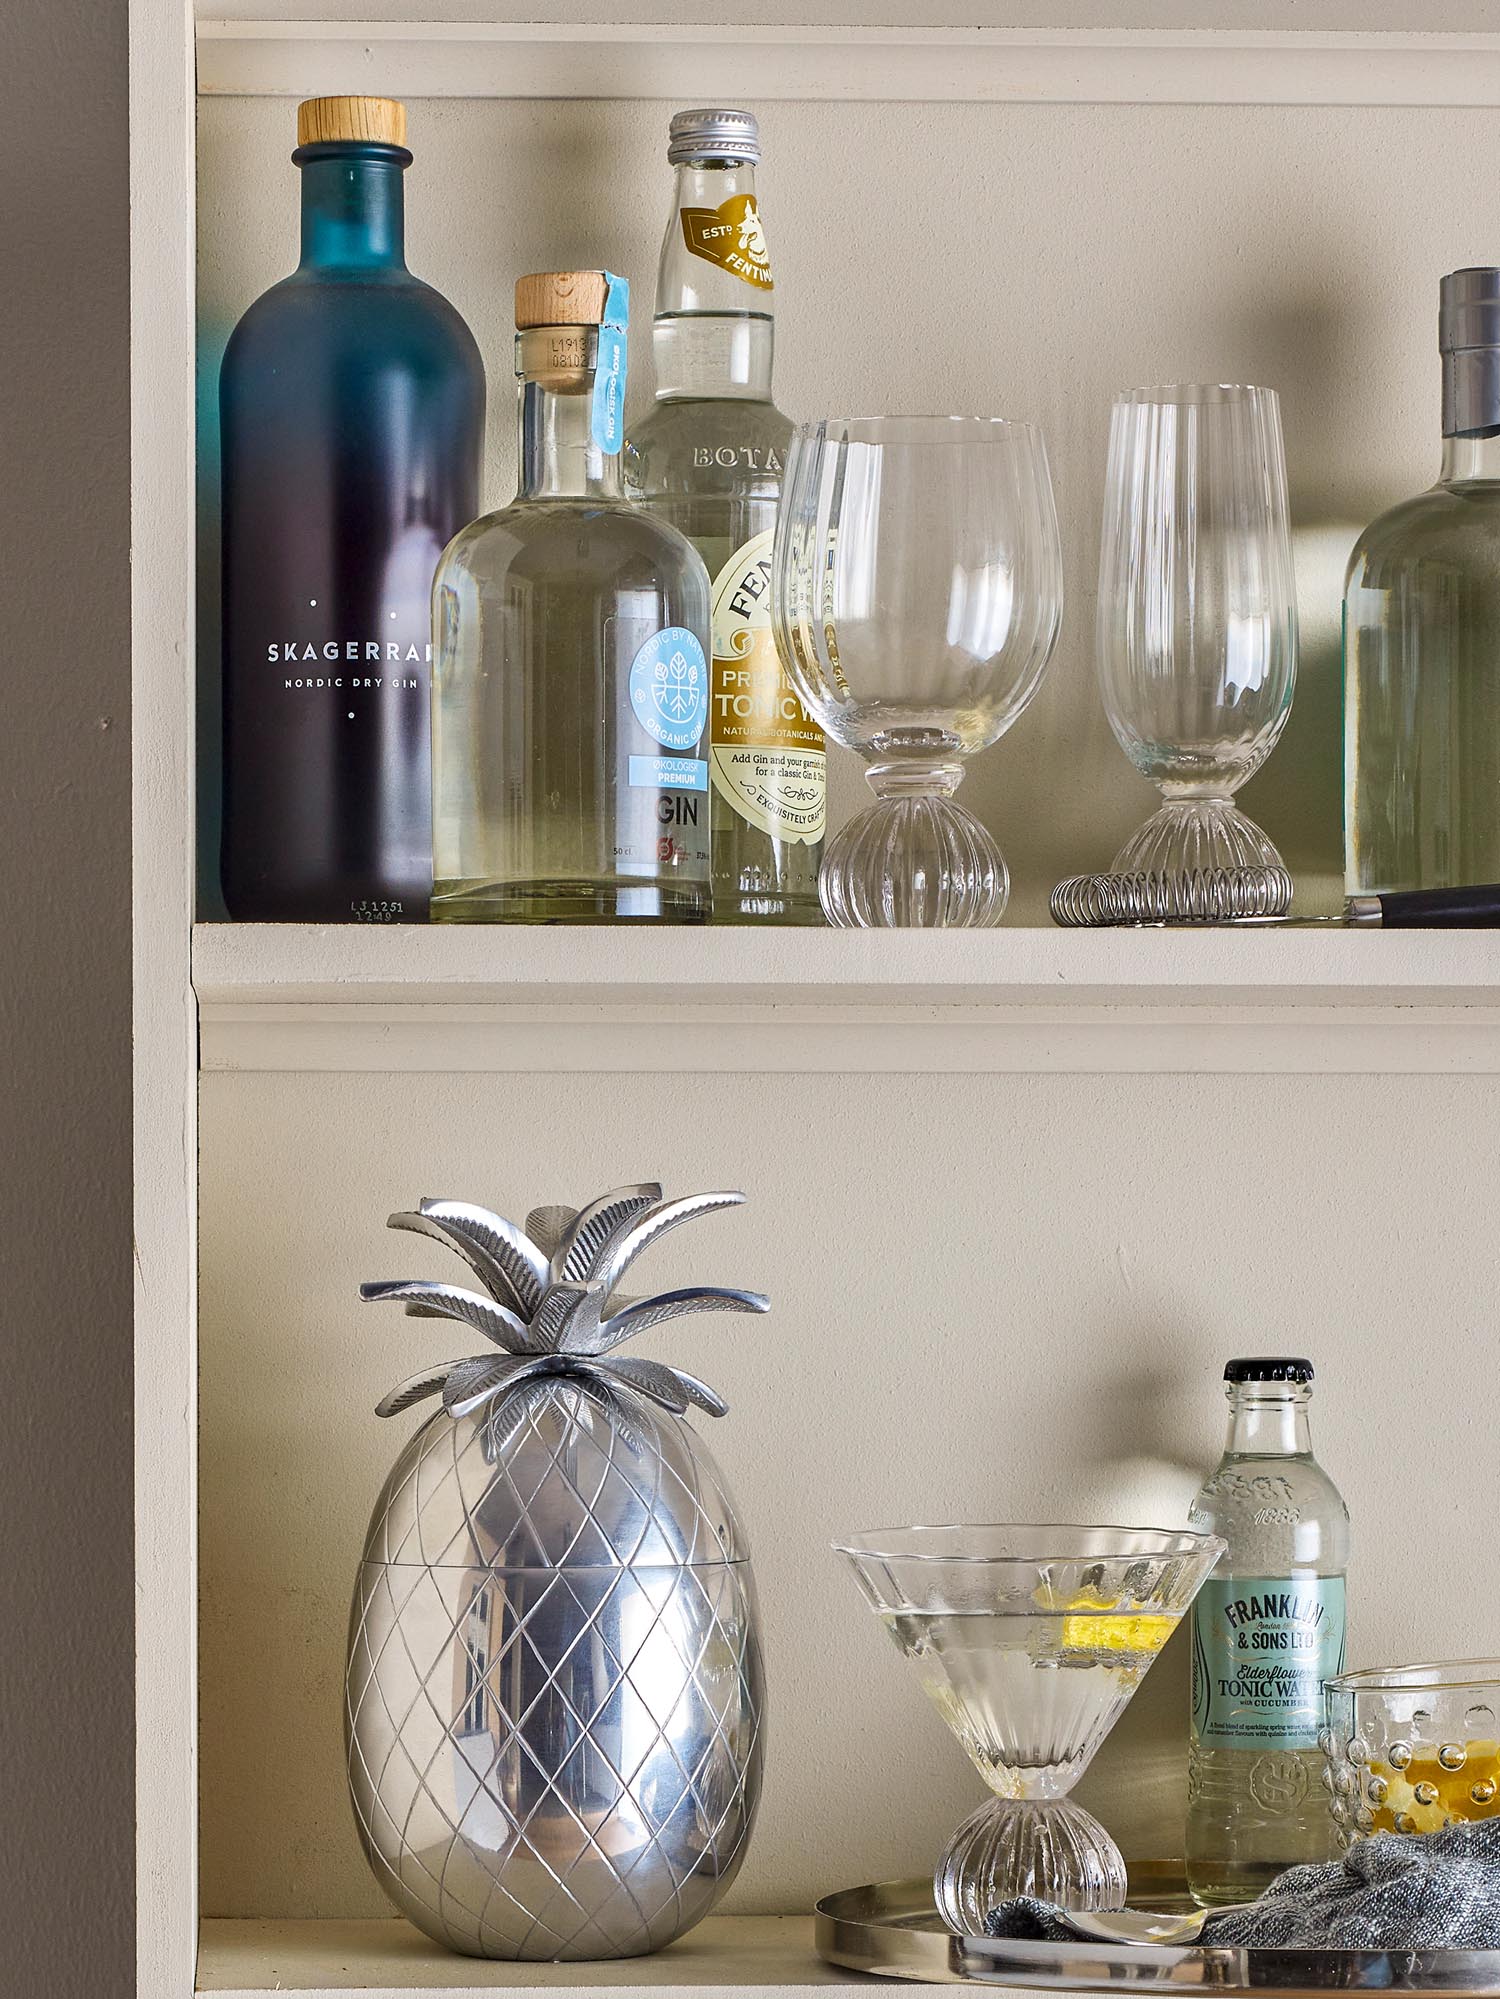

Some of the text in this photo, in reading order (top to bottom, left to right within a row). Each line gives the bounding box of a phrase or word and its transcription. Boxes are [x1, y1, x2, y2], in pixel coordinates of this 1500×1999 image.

[693, 446, 789, 470] BOTA
[635, 632, 669, 674] NORDIC
[672, 630, 685, 641] BY
[285, 678, 417, 688] NORDIC DRY GIN
[715, 693, 797, 720] TONIC
[646, 718, 703, 744] ORGANIC GIN
[731, 754, 751, 763] Add
[753, 755, 768, 764] Gin
[770, 756, 786, 765] and
[787, 759, 802, 768] your
[658, 773, 696, 785] PREMIUM
[755, 766, 768, 776] for
[778, 768, 801, 778] classic
[803, 771, 813, 780] Gin
[656, 795, 698, 826] GIN
[756, 794, 806, 824] EXQUISITELY
[613, 847, 623, 856] 50
[1224, 1594, 1325, 1629] FRANKLIN
[1238, 1632, 1249, 1649] &
[1251, 1632, 1289, 1649] SONS
[1218, 1680, 1273, 1697] TONIC
